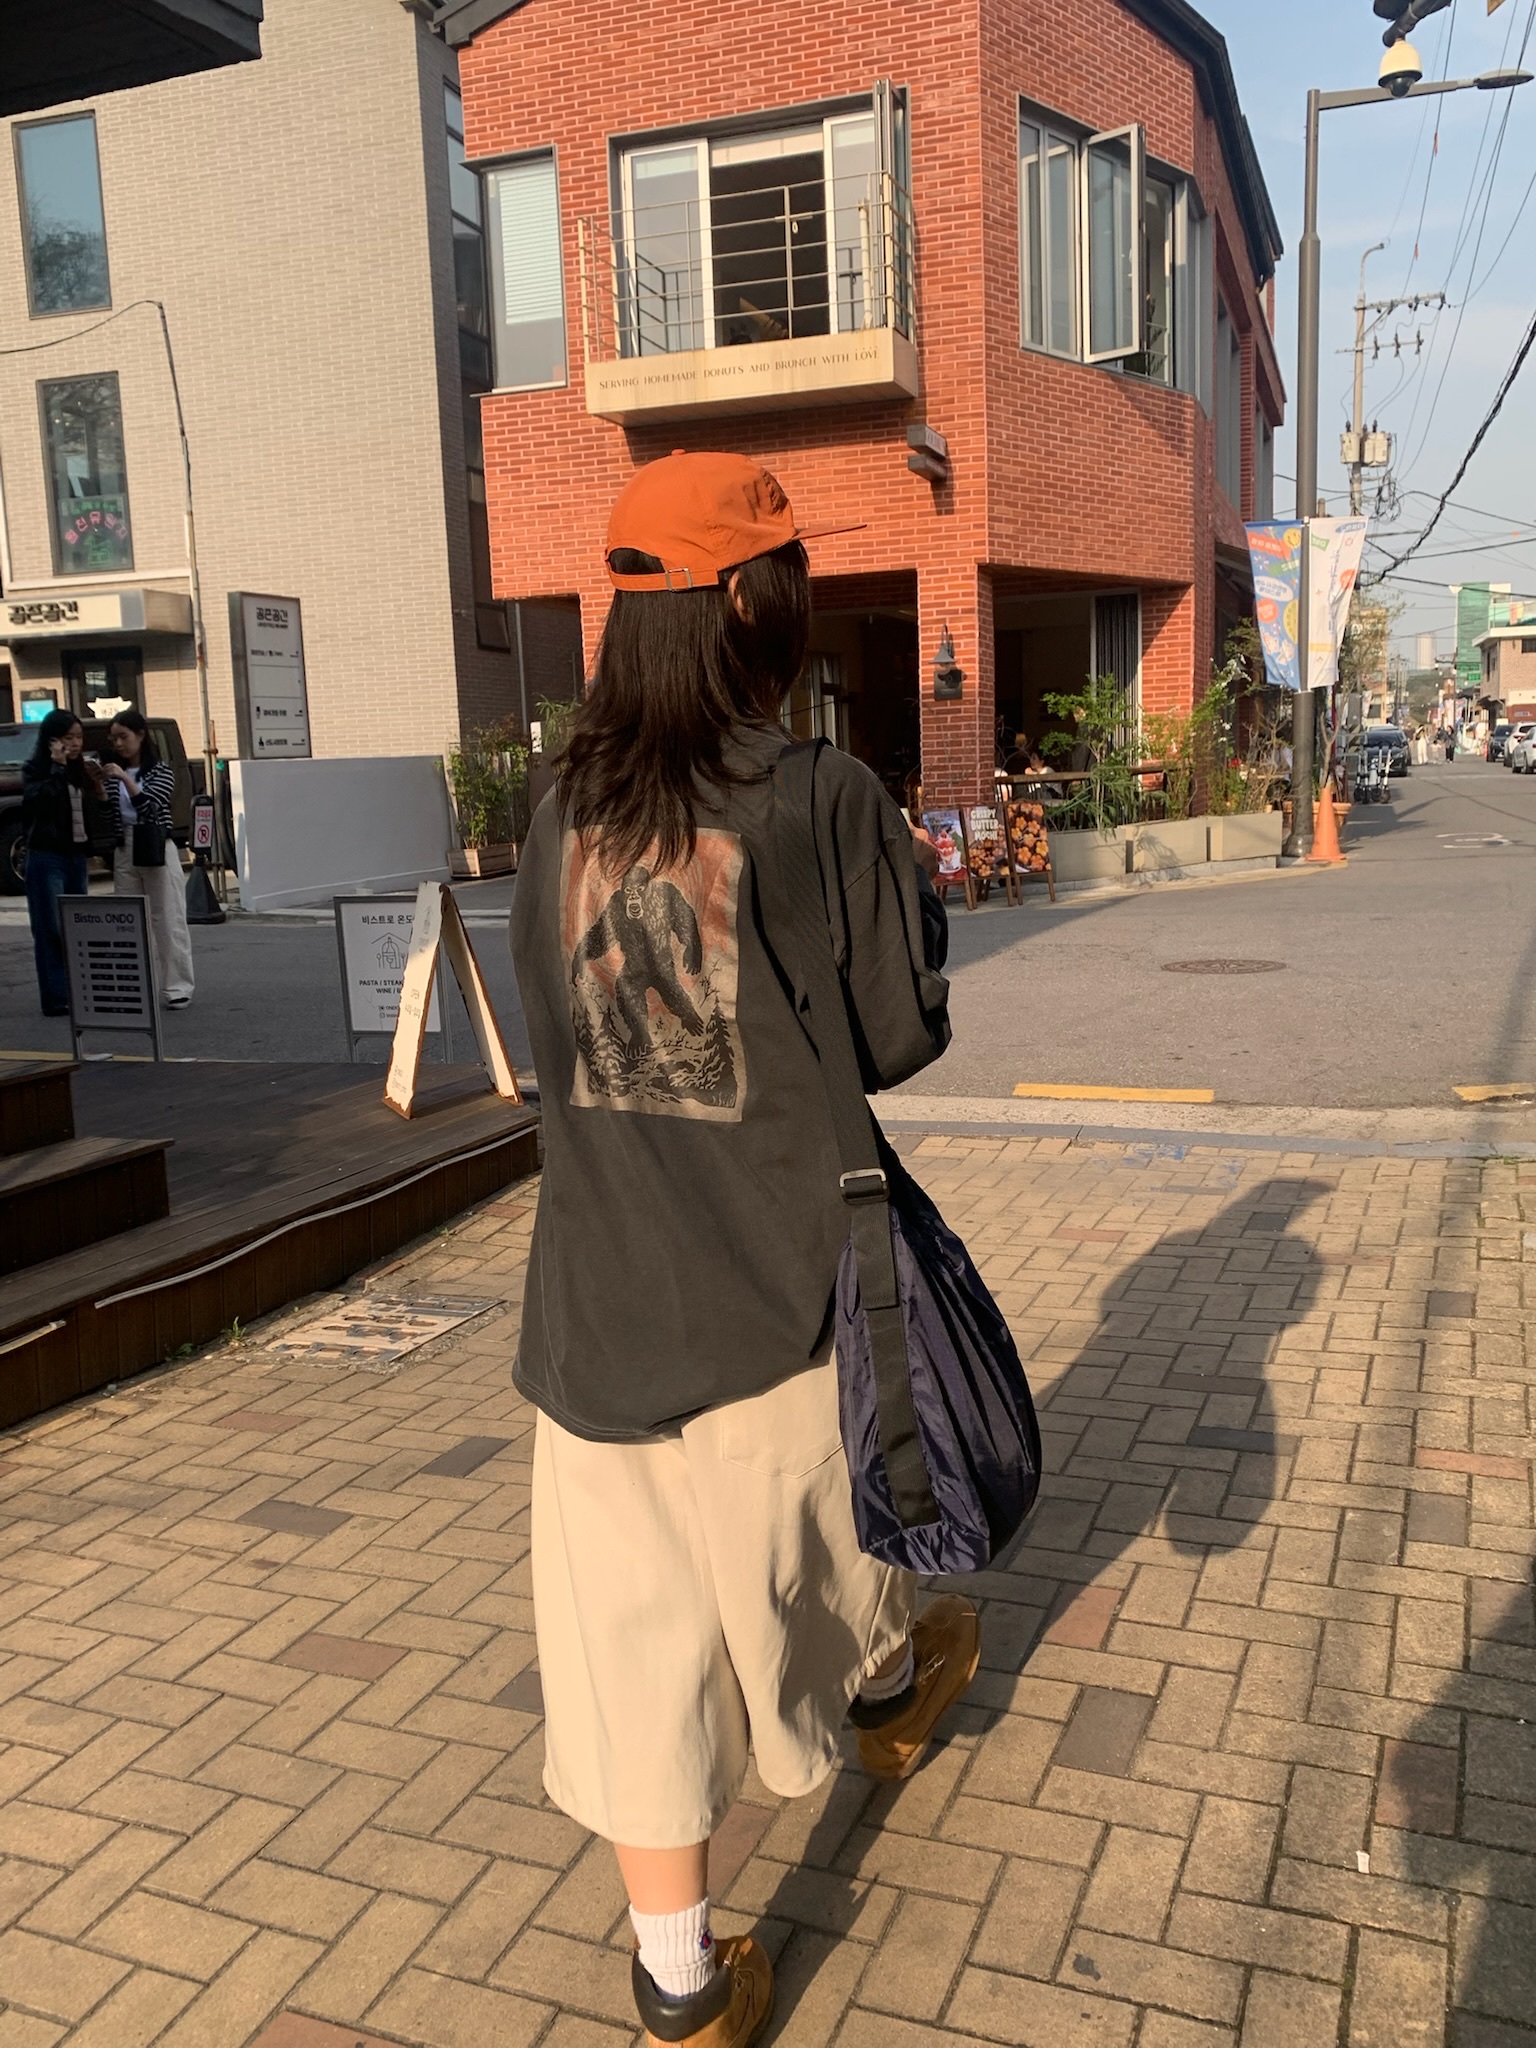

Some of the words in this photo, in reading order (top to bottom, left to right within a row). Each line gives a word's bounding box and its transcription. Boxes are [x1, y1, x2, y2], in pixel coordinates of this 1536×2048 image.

[599, 377, 639, 390] SERVING
[644, 370, 698, 385] HOMEMADE
[703, 365, 744, 378] DONUTS
[749, 362, 770, 373] AND
[775, 356, 816, 370] BRUNCH
[821, 353, 849, 364] WITH
[854, 348, 879, 361] LOVE
[970, 808, 996, 819] CRISPY
[971, 819, 999, 831] BUTTER
[974, 830, 998, 841] MOCHI
[104, 913, 135, 924] ONDO
[361, 914, 395, 925] 비스트로
